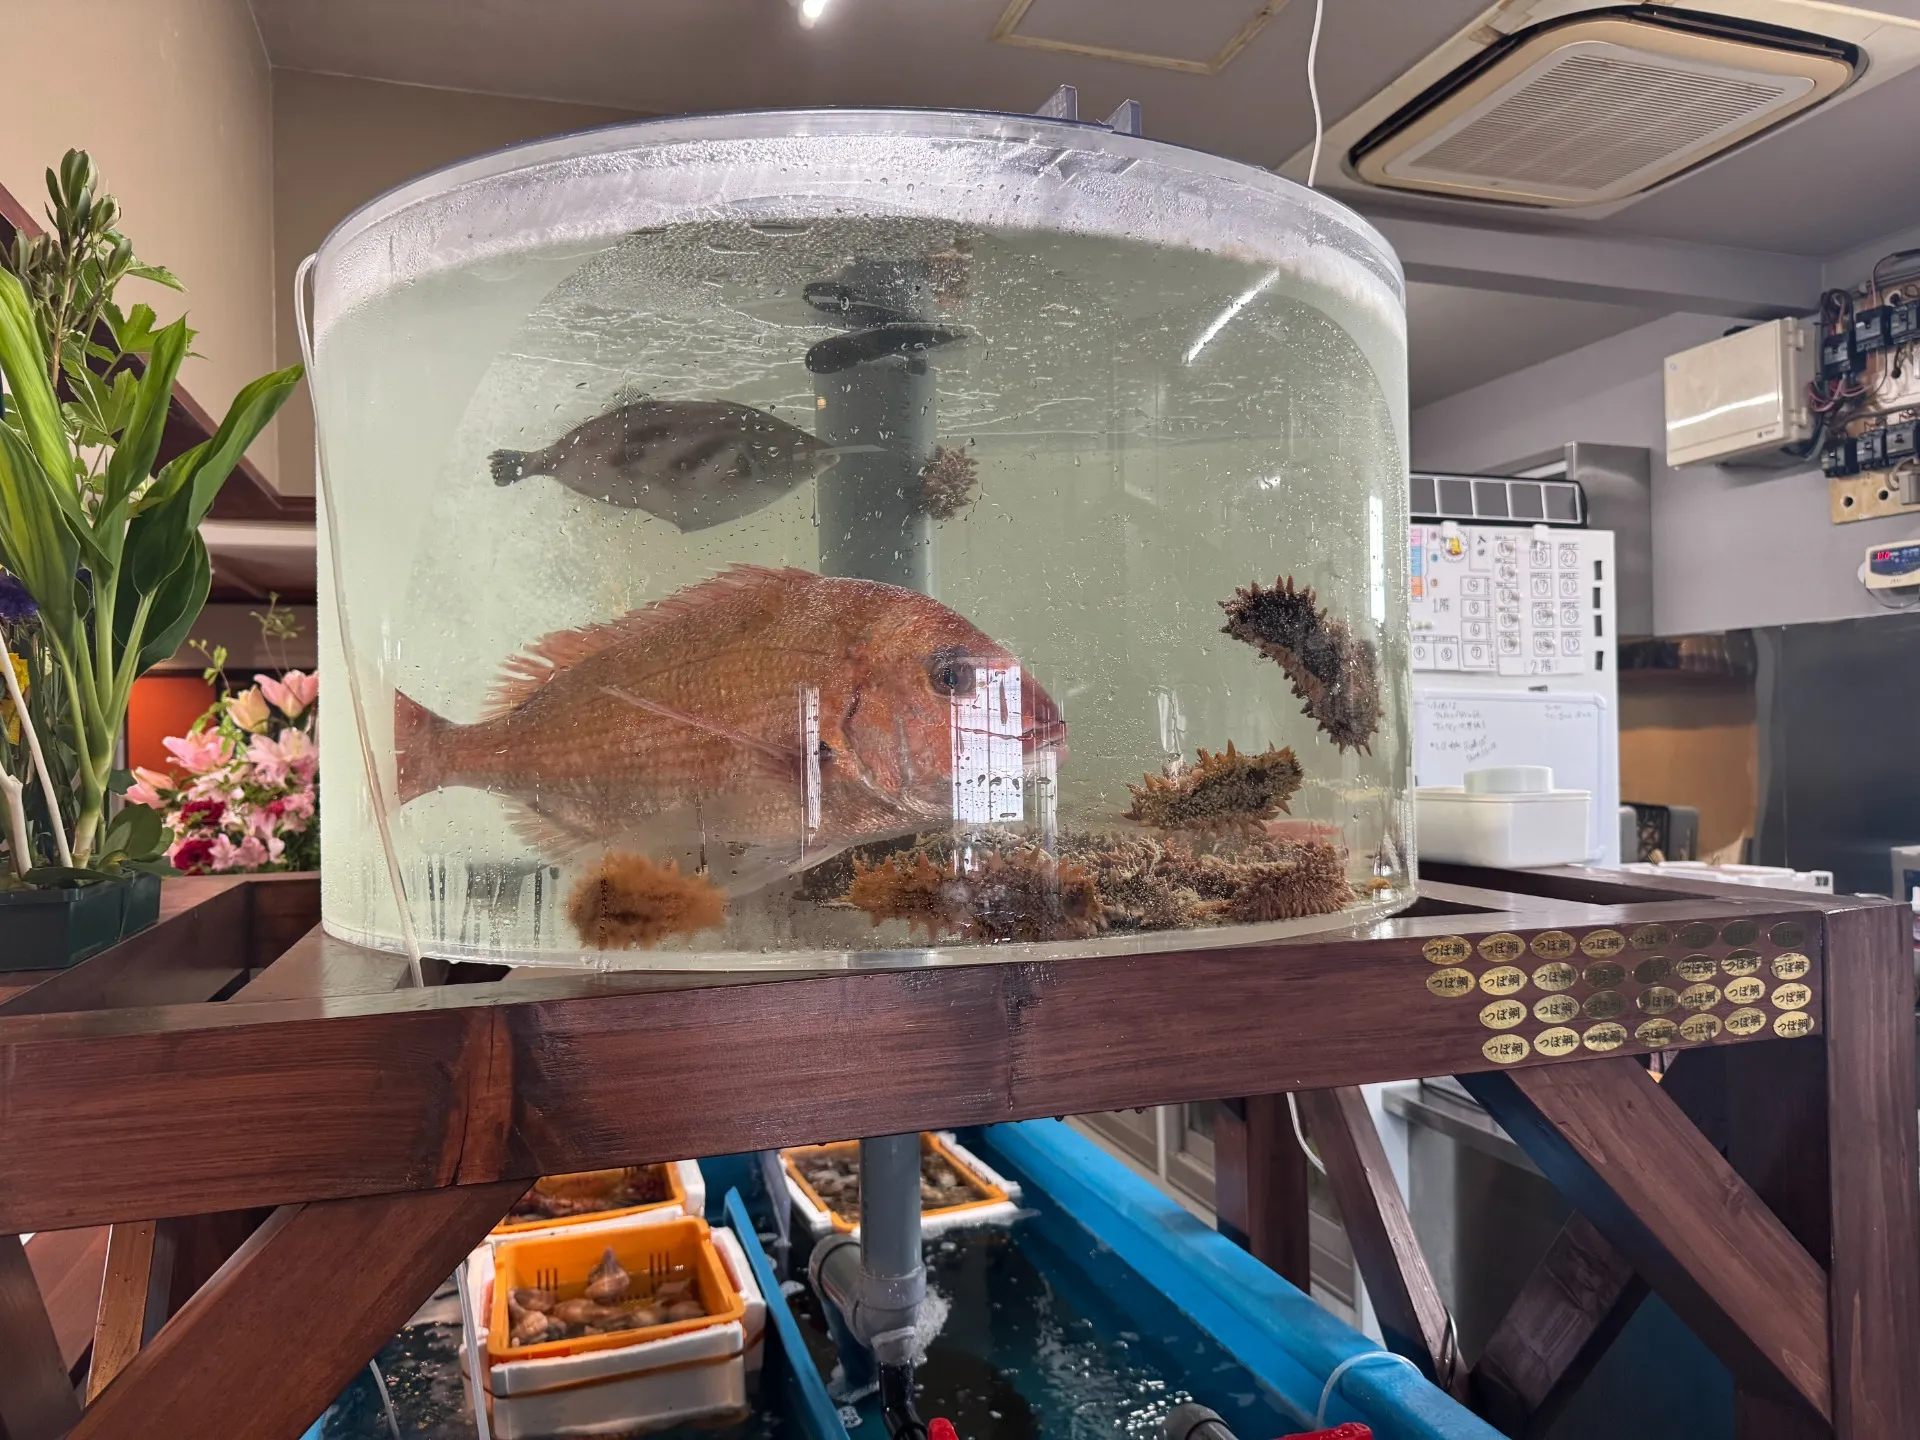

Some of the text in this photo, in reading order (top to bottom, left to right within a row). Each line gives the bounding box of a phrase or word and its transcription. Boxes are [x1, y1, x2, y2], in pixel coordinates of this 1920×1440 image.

[1428, 944, 1465, 956] つぼ鯛
[1585, 937, 1618, 950] つぼ鯛
[1775, 961, 1805, 973] つぼ鯛
[1432, 976, 1468, 988] つぼ鯛
[1484, 974, 1519, 988] つぼ鯛
[1729, 984, 1760, 997] つぼ鯛
[1775, 991, 1806, 1003] つぼ鯛
[1485, 1007, 1520, 1021] つぼ鯛
[1538, 1003, 1573, 1015] つぼ鯛
[1730, 1015, 1760, 1029] つぼ鯛
[1540, 1035, 1574, 1048] つぼ鯛
[1488, 1042, 1523, 1055] つぼ鯛
